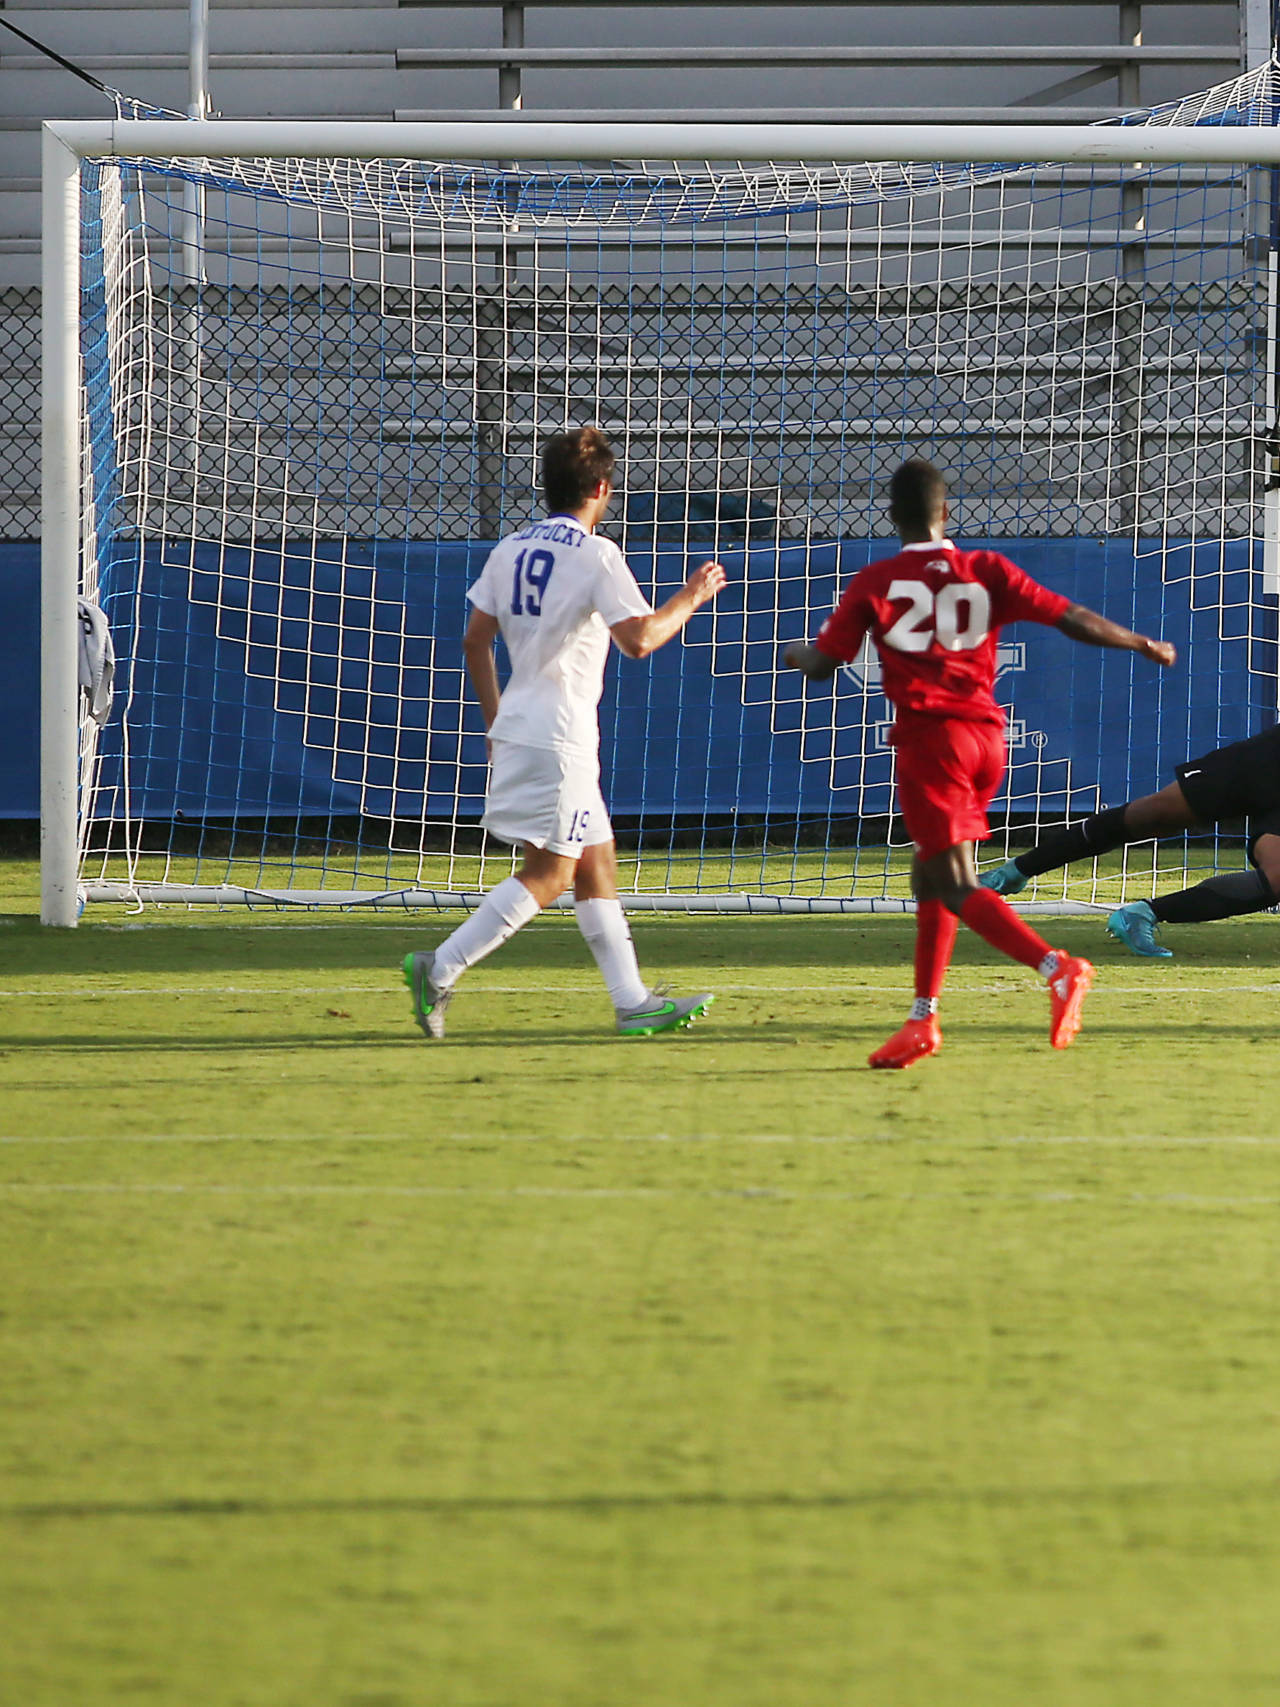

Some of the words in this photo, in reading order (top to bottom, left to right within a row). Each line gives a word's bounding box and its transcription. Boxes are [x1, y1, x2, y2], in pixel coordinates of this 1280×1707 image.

[510, 547, 555, 616] 19
[883, 579, 991, 652] 20
[567, 808, 590, 842] 19
